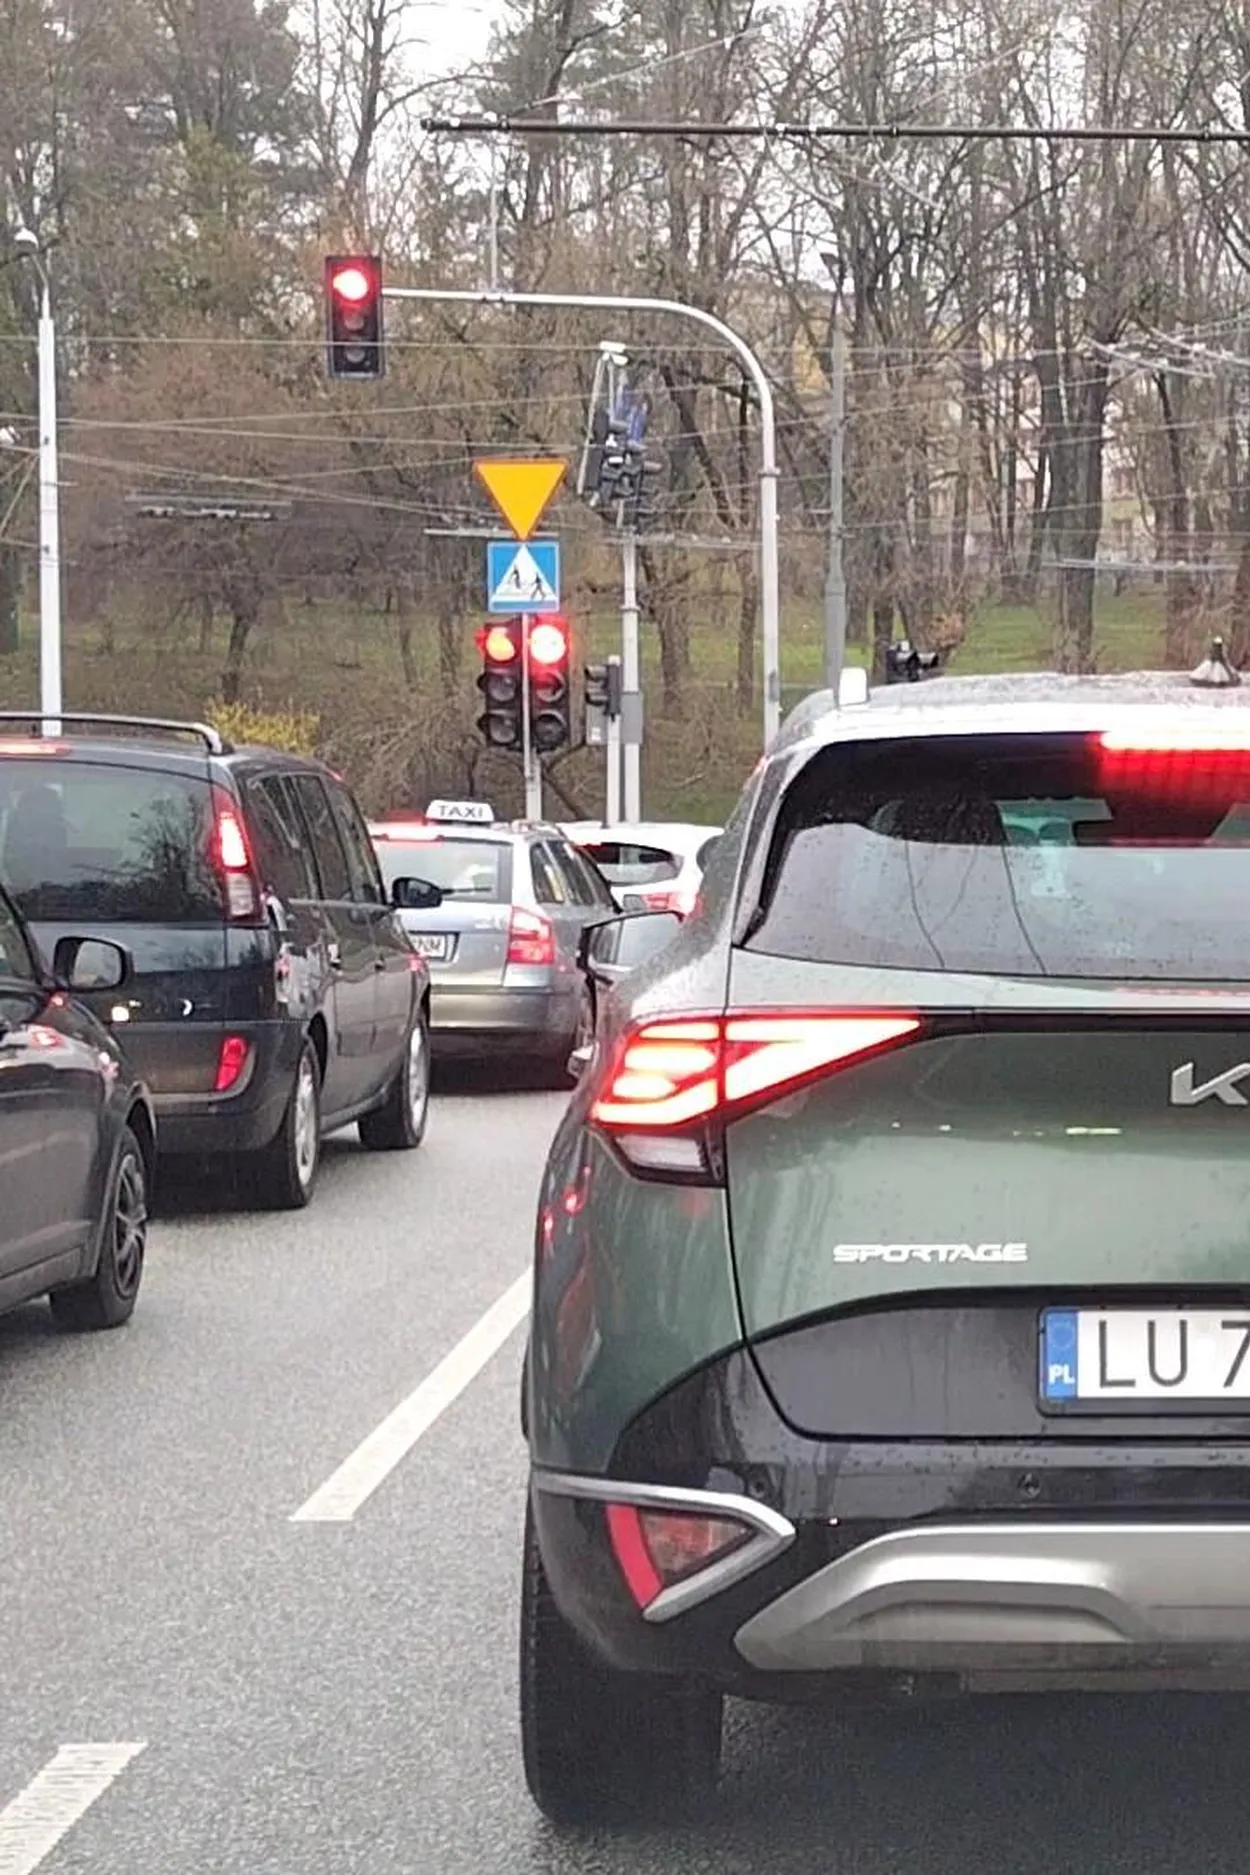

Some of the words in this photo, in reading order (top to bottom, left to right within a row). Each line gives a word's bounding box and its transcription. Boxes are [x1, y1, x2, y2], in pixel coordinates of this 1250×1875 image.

[437, 804, 484, 818] TAXI
[832, 1243, 1029, 1263] SPORTAGE
[1098, 1319, 1188, 1388] LU
[1047, 1365, 1076, 1385] PL
